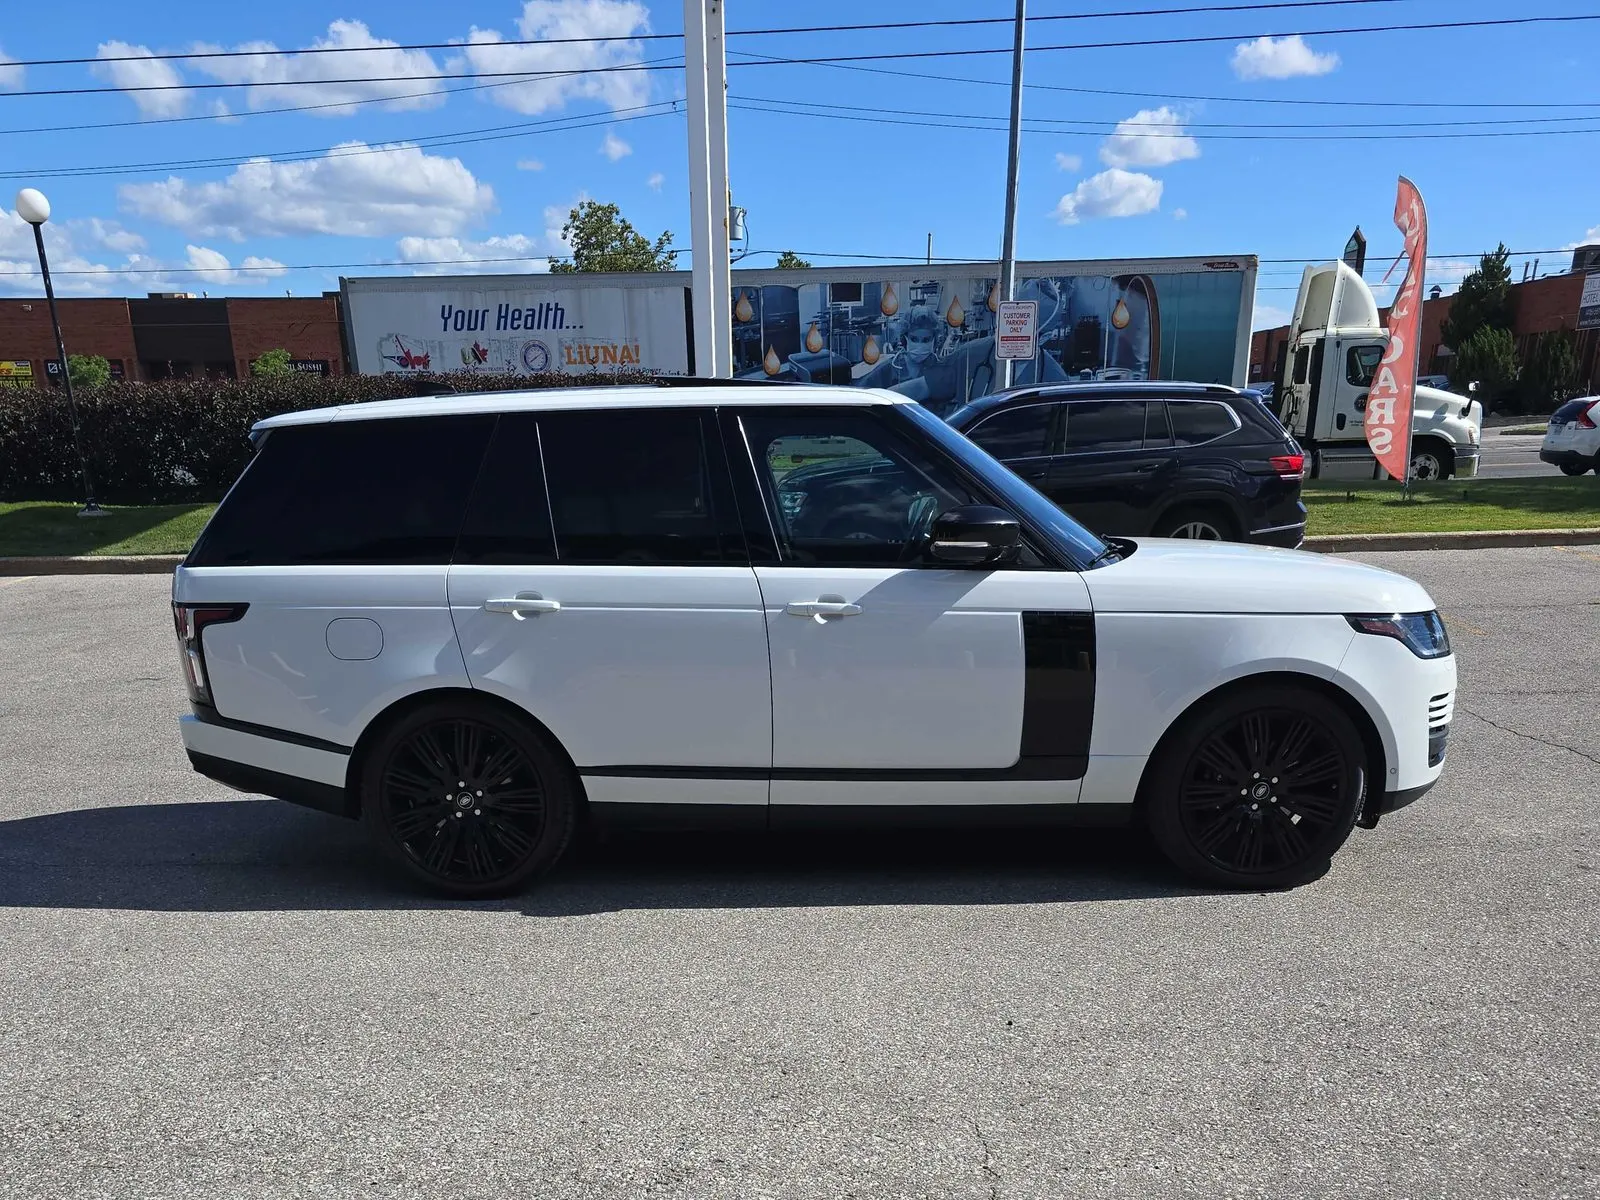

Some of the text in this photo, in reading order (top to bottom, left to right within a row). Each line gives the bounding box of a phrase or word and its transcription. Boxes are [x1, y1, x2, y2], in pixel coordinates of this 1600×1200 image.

[441, 302, 584, 332] Your Health...
[564, 343, 641, 365] LiUNA!
